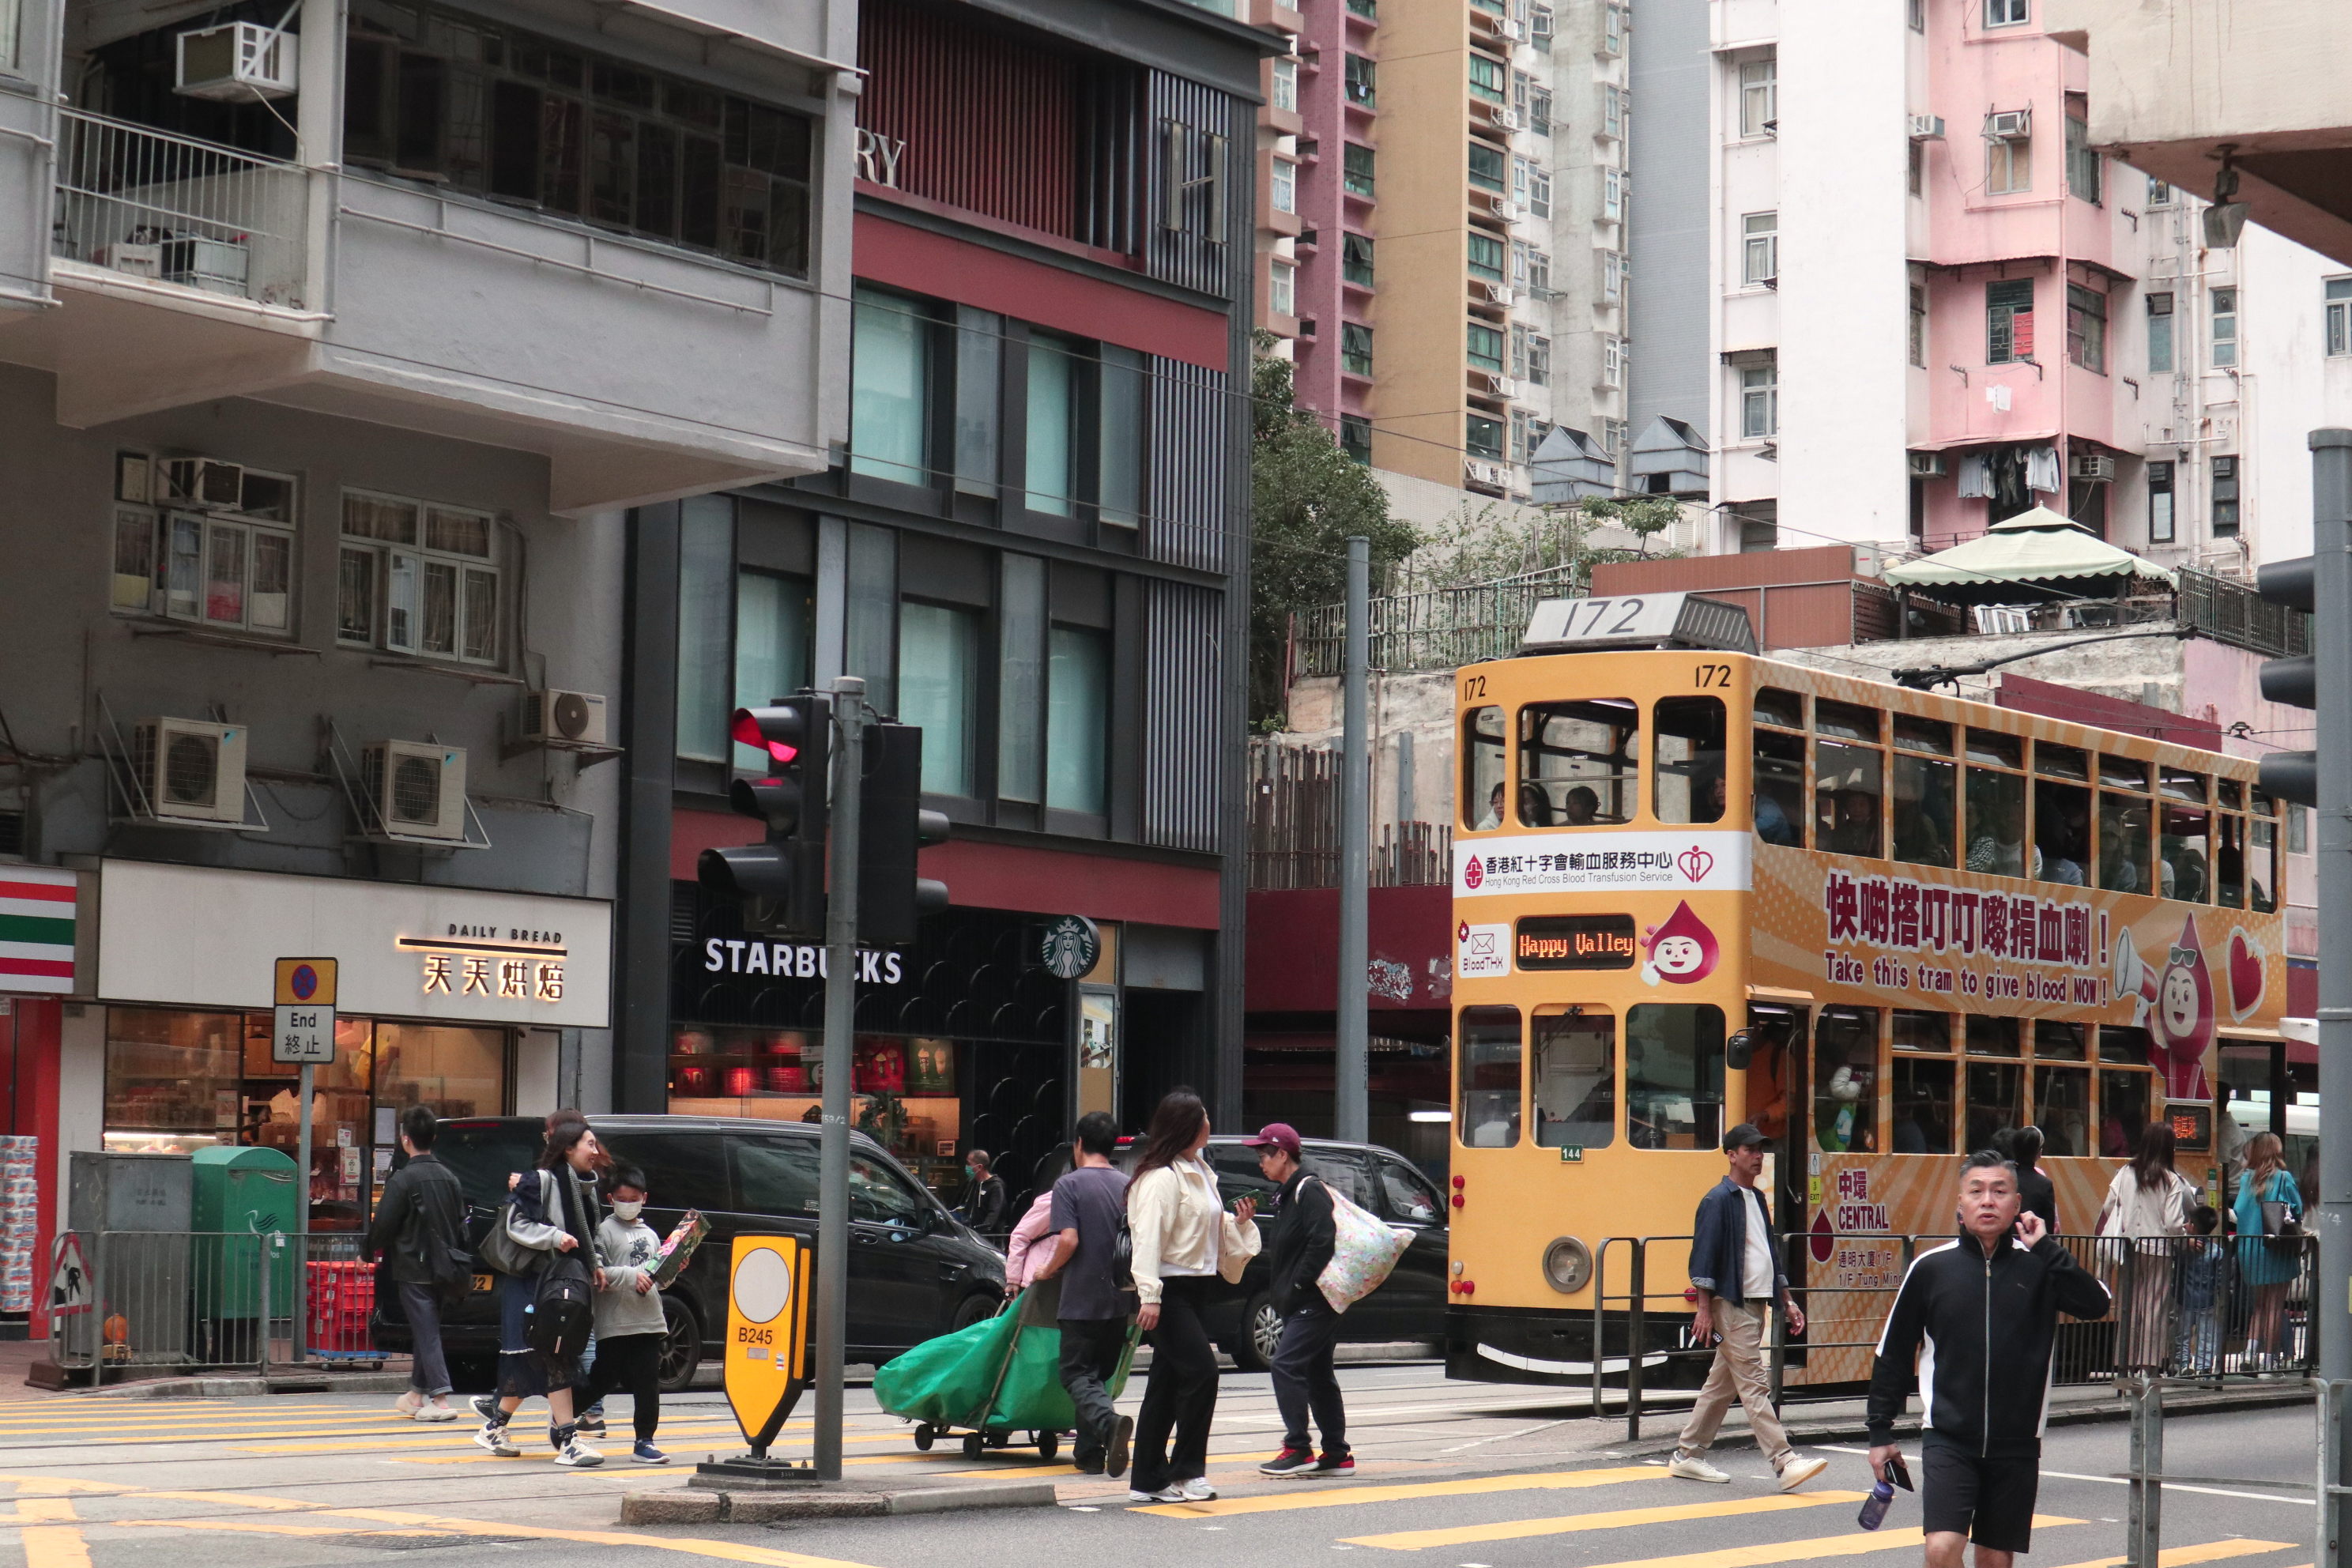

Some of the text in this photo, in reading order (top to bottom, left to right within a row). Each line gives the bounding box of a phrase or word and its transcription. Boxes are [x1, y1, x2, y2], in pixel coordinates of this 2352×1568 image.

[1562, 597, 1645, 638] 172
[1695, 665, 1732, 688] 172
[1464, 675, 1487, 702] 172
[1486, 851, 1673, 875] 香港紅十字會輸血服務中心
[1485, 871, 1673, 888] Hong Kong Red Cross Blood Transfusion Service
[448, 923, 562, 944] DAILY BREAD
[1519, 933, 1634, 958] Happy Valley
[704, 937, 902, 985] STARBKS
[1463, 956, 1504, 971] BloodTHX
[426, 956, 564, 1001] 天天烘焙
[1825, 952, 1864, 983] Take
[1873, 957, 1909, 987] this
[1918, 963, 1952, 991] tram
[1961, 968, 1977, 993] to
[1985, 969, 2019, 1000] give
[2026, 972, 2067, 1002] blood
[291, 1012, 316, 1027] End
[285, 1034, 321, 1055] 終止
[1562, 1148, 1581, 1159] 144
[1838, 1170, 1868, 1200] 中環
[1838, 1204, 1890, 1231] CENTRAL
[1838, 1250, 1892, 1268] 通明大廈1/F
[1838, 1272, 1853, 1287] 1/F
[1857, 1272, 1879, 1287] Tung
[738, 1327, 773, 1345] B245
